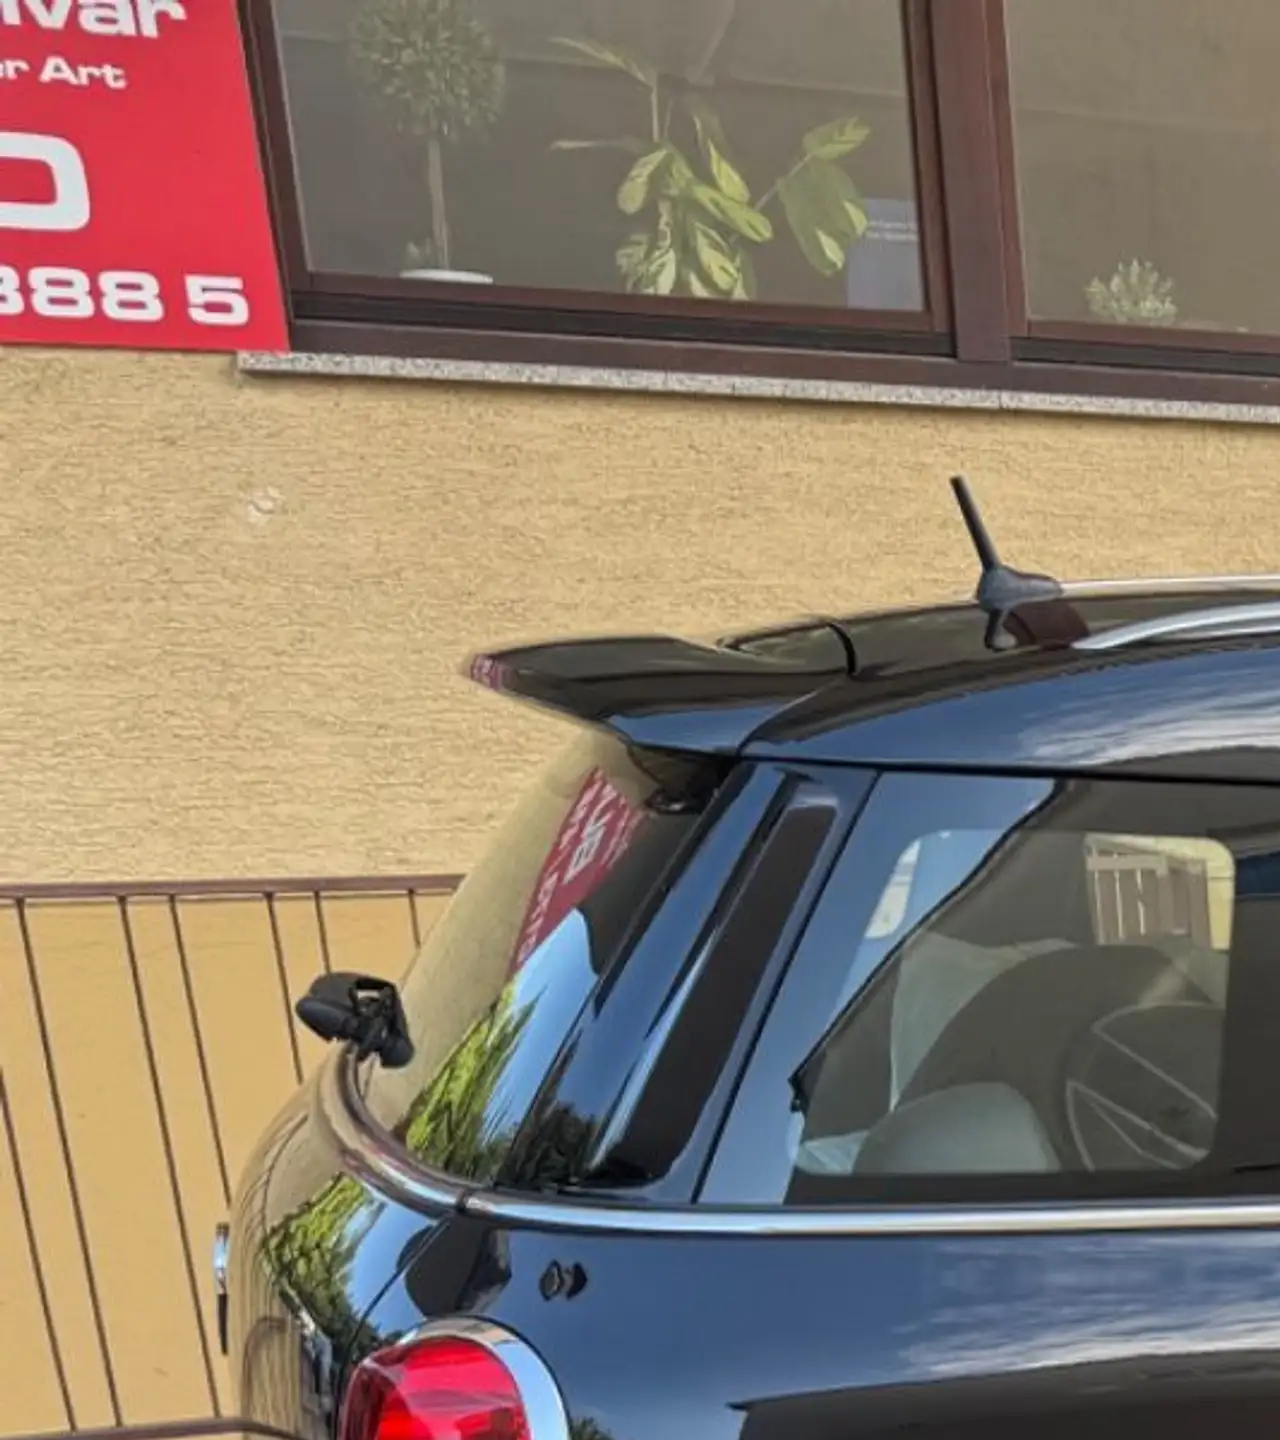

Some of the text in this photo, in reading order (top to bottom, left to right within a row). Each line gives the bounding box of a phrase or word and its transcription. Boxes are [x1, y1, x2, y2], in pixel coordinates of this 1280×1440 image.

[0, 55, 127, 89] r Art
[184, 273, 249, 326] 5
